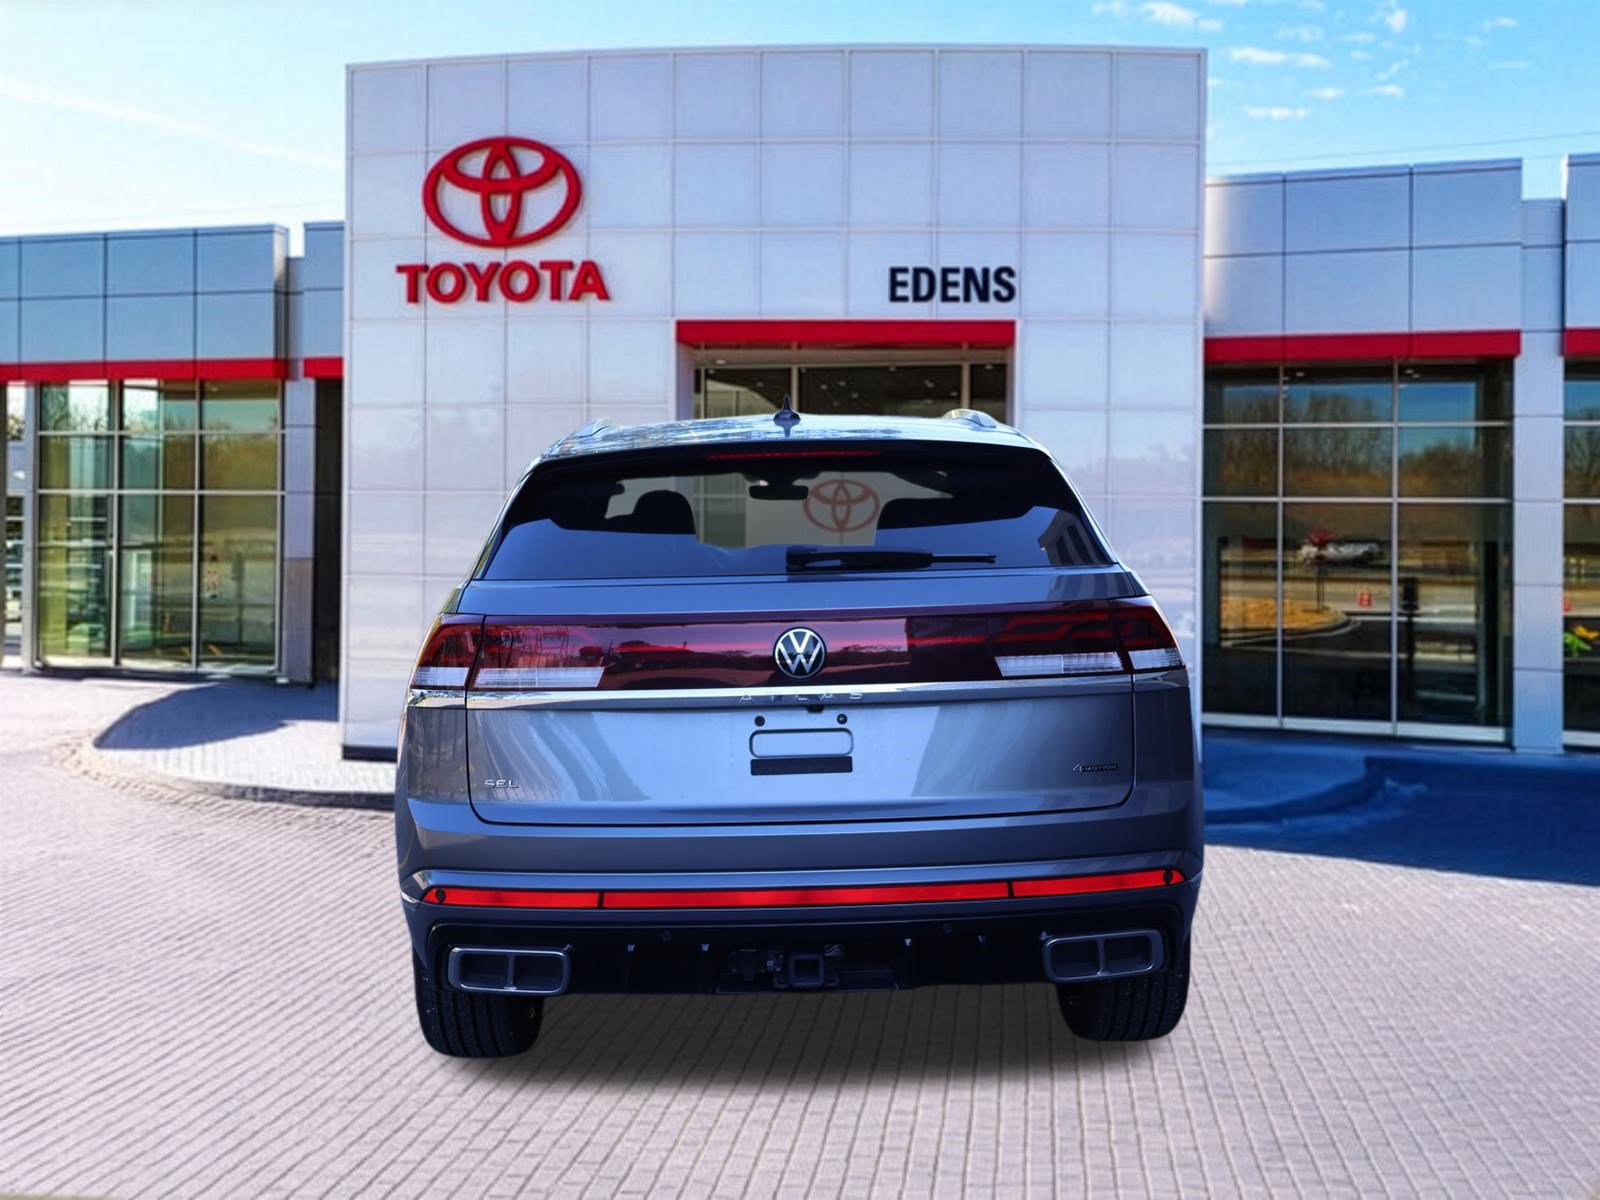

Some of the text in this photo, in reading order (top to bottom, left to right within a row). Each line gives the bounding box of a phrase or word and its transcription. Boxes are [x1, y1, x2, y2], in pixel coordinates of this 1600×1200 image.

[396, 260, 610, 304] TOYOTA
[889, 266, 1017, 303] EDENS
[776, 629, 824, 677] VW
[484, 779, 519, 789] SEL
